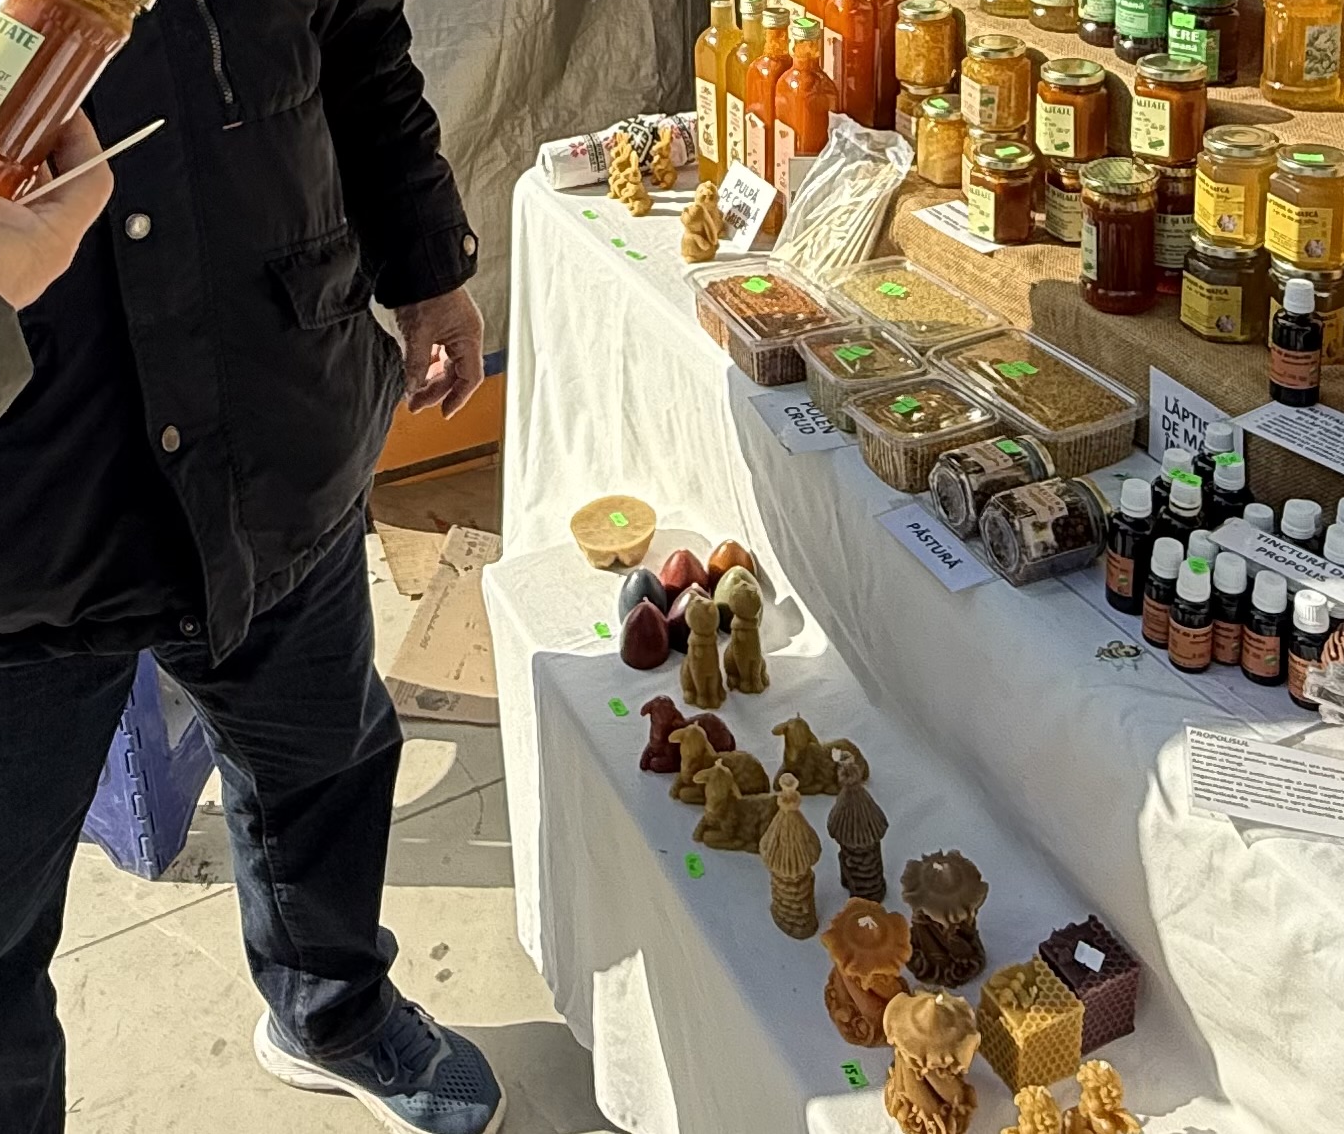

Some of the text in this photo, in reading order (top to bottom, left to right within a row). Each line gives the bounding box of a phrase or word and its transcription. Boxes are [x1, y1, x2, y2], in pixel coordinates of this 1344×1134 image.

[783, 406, 816, 435] CRUD
[800, 400, 837, 435] POLEN
[1162, 415, 1180, 439] DE
[1164, 395, 1210, 440] LĂPTIȘ
[906, 521, 964, 571] PĂSTURĂ
[1256, 532, 1327, 571] TINCTURĂ
[1256, 546, 1330, 584] PROPOLIS
[1189, 729, 1250, 748] PROPOLISUL
